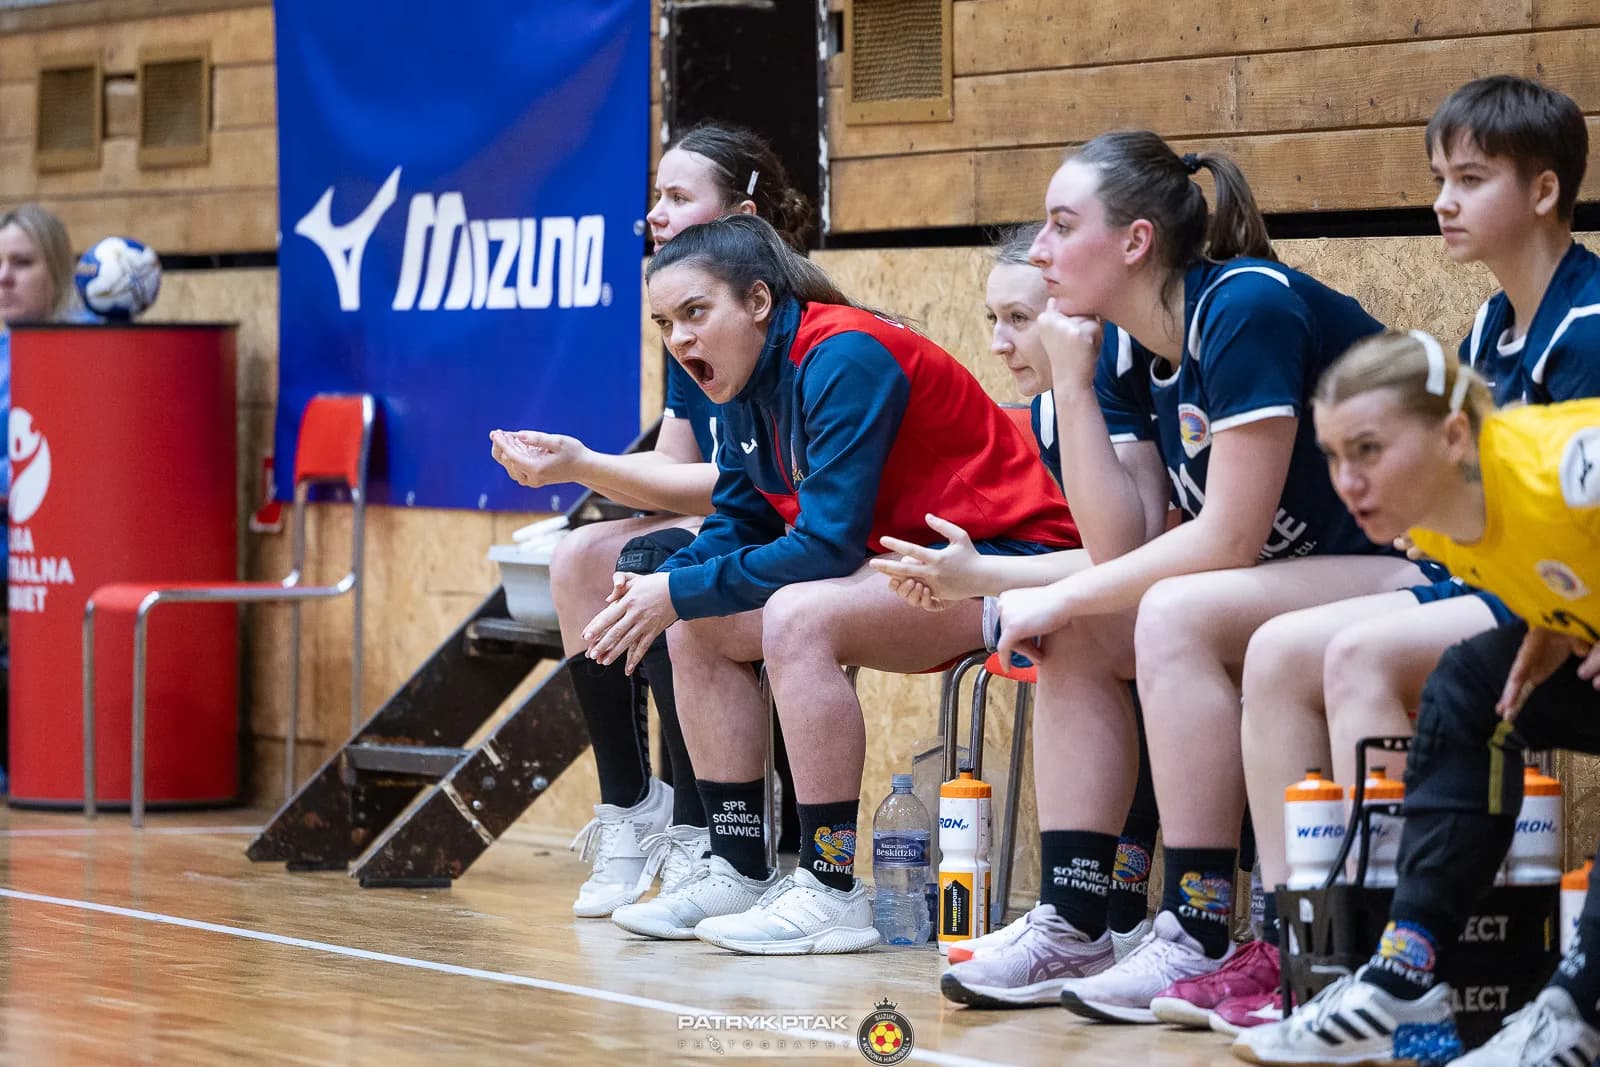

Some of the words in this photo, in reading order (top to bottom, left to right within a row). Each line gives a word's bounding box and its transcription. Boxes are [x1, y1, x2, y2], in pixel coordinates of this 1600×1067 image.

[392, 192, 604, 311] MIZUNO
[722, 801, 746, 811] SPR
[712, 812, 761, 825] SOŚNICA
[715, 825, 761, 838] GLIWICE
[876, 848, 916, 857] Beskidzki
[1071, 858, 1100, 870] SPR
[1110, 880, 1148, 895] IWICE
[1458, 916, 1508, 941] ECT
